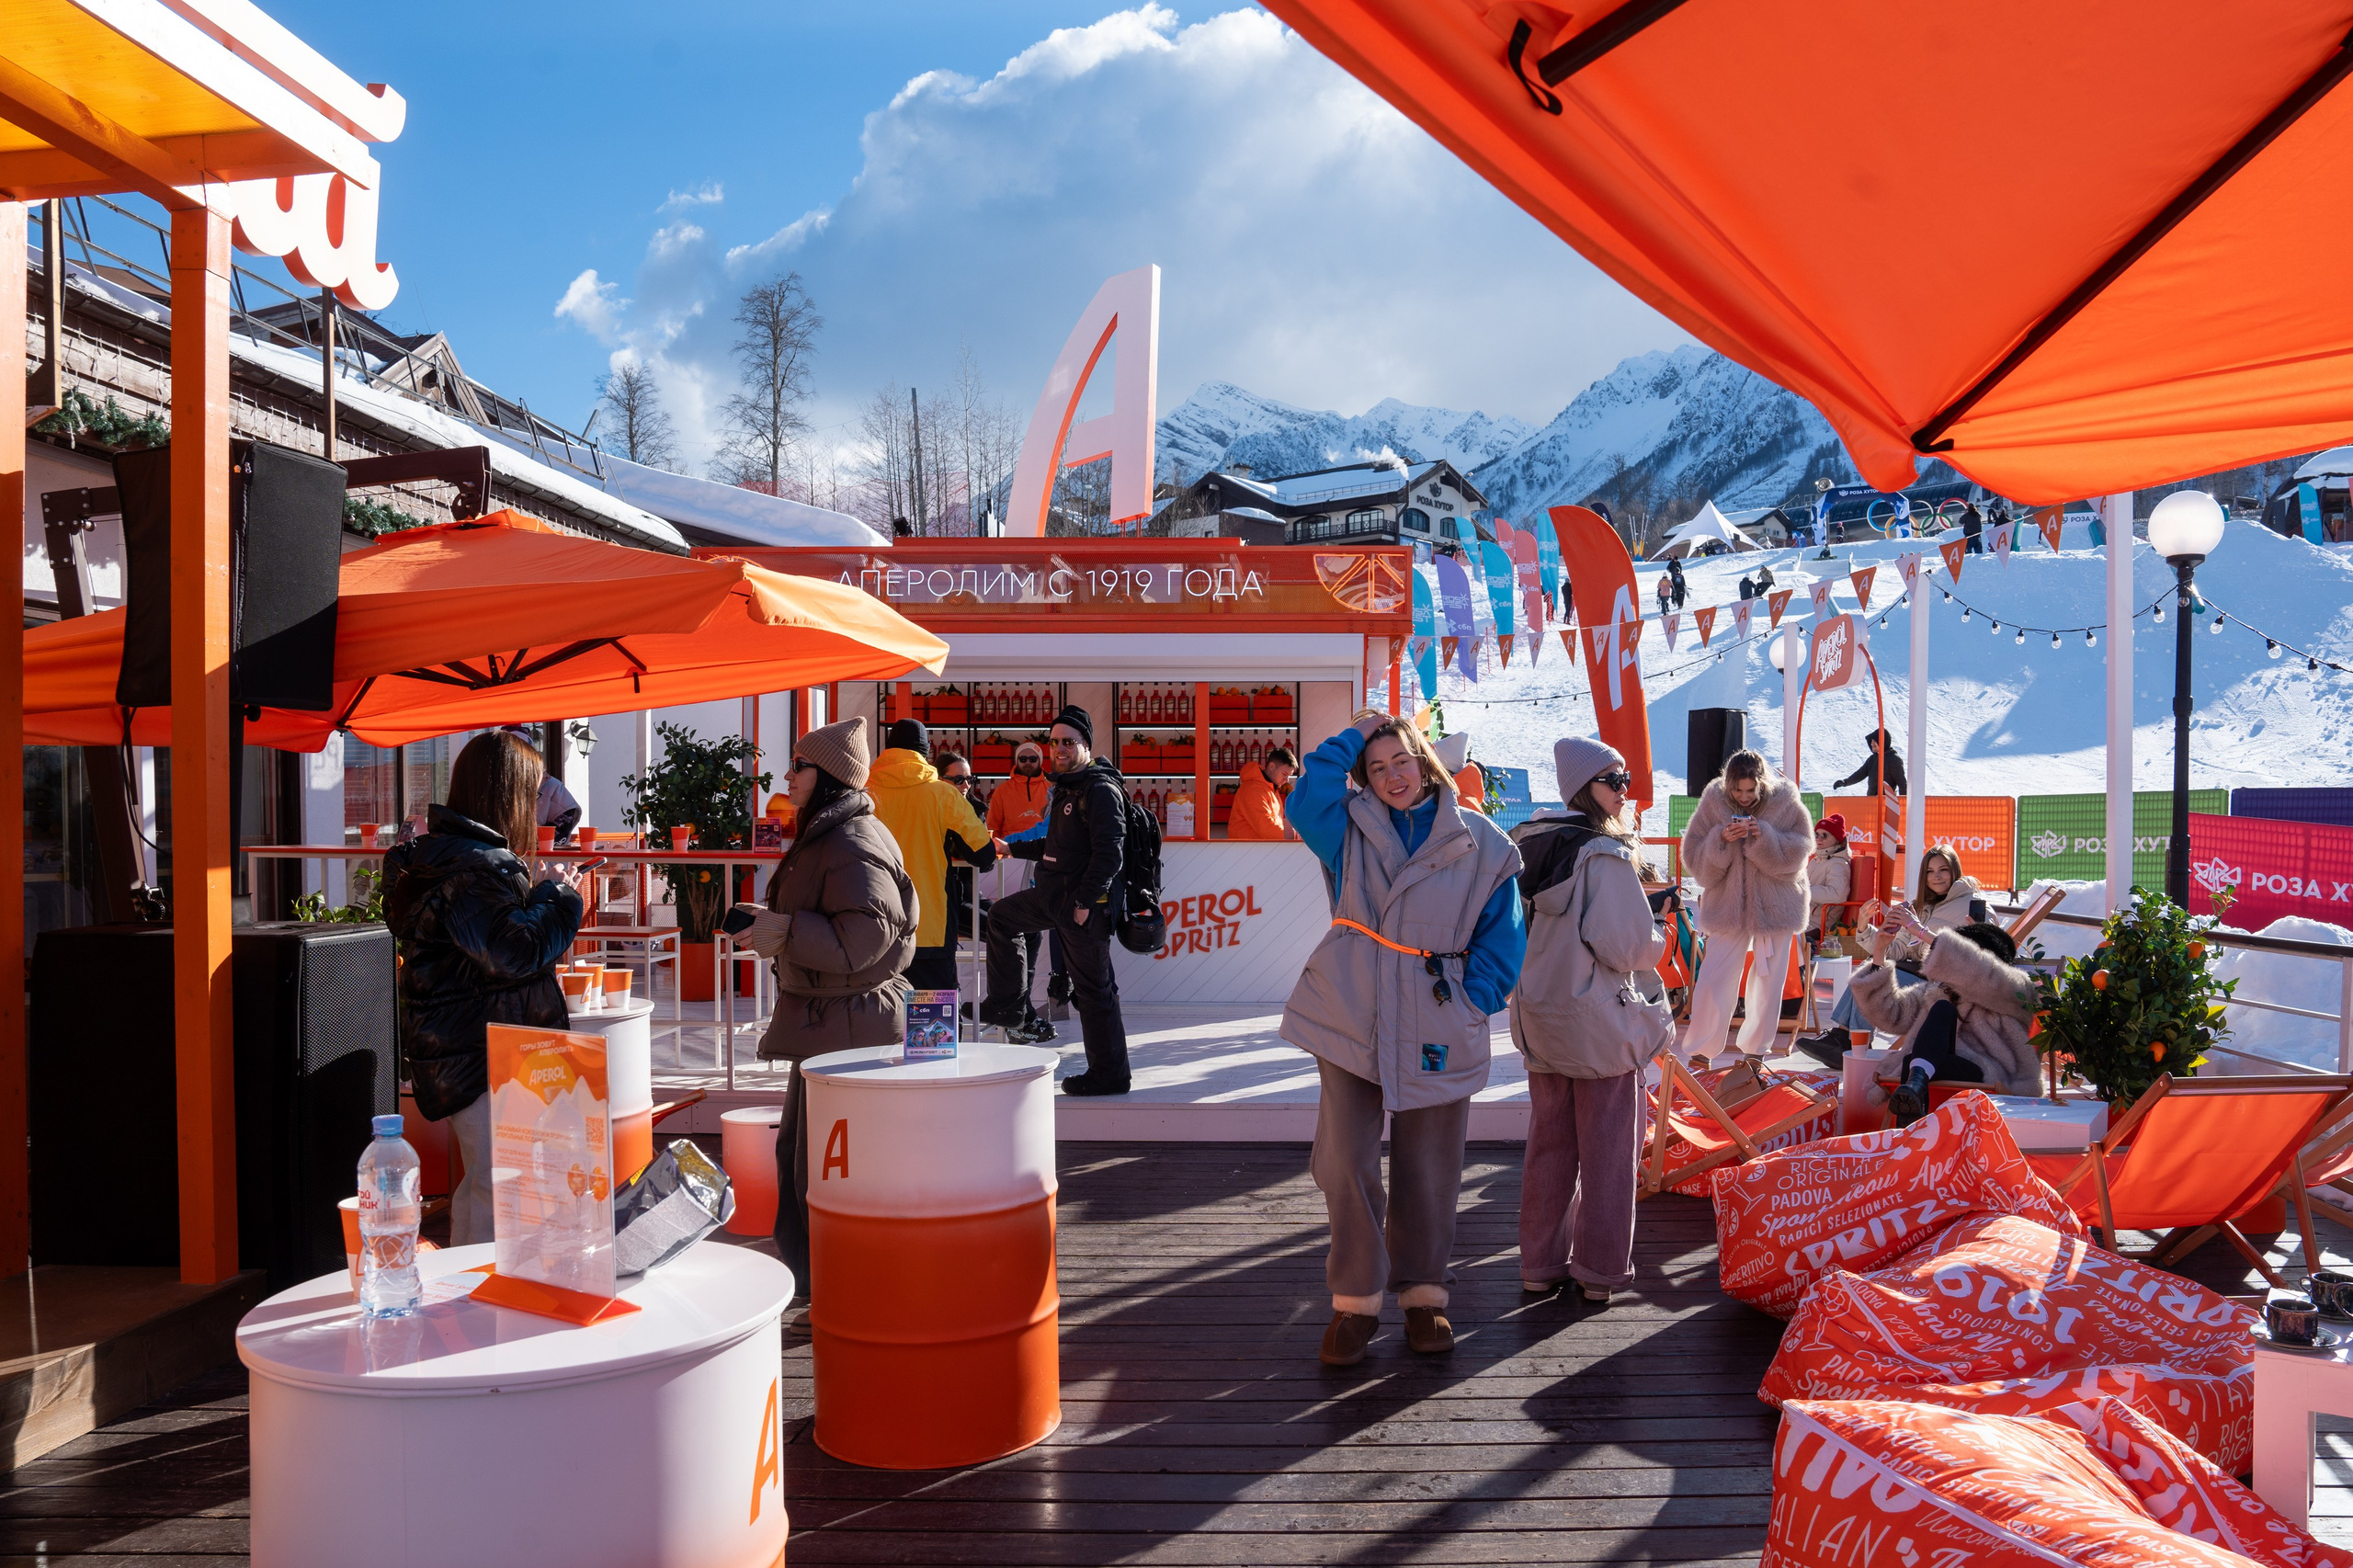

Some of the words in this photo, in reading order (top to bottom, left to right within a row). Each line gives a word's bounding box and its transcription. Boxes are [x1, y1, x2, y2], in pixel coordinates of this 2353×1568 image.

[1416, 495, 1433, 506] РОЗА
[1434, 500, 1454, 512] ХУТОР
[2046, 514, 2058, 534] A
[1996, 530, 2007, 549] A
[1949, 547, 1960, 565] A
[1906, 562, 1915, 581] A
[839, 570, 1034, 597] АПЕРОЛИМ
[1050, 570, 1073, 597] С
[1086, 570, 1153, 597] 1919
[1167, 570, 1263, 600] ГОДА
[1859, 575, 1869, 593] A
[1772, 596, 1784, 612] A
[1815, 587, 1825, 604] A
[1701, 614, 1711, 631] A
[1737, 606, 1747, 622] A
[1629, 627, 1638, 642] A
[1667, 619, 1676, 635] A
[1391, 639, 1401, 651] A
[1416, 642, 1426, 653] A
[1471, 641, 1479, 653] A
[1502, 640, 1509, 653] A
[1532, 637, 1540, 652] A
[1566, 634, 1574, 651] A
[1597, 631, 1605, 646] A
[1608, 583, 1644, 711] A
[1815, 621, 1847, 673] APEROL
[1444, 642, 1453, 655] A
[2252, 872, 2323, 899] РОЗА
[1161, 885, 1262, 932] PEROL
[519, 1043, 536, 1051] ГОРЫ
[537, 1040, 556, 1049] ЗОВУТ
[539, 1045, 574, 1057] АПЕРОЛИТЬ
[529, 1065, 566, 1085] APEROL
[822, 1118, 849, 1181] A
[1790, 1156, 1871, 1174] RICETTA
[1778, 1159, 1884, 1190] ORIGINALE
[1771, 1187, 1833, 1211] PADOVA
[1779, 1222, 1822, 1248] RADICI
[1827, 1192, 1904, 1230] SELEZIONATE
[2095, 1286, 2188, 1336] SELEZIONATE
[1949, 1308, 2053, 1353] CONTAGIOUS
[749, 1375, 779, 1527] A
[1875, 1451, 1938, 1483] RADICI
[1943, 1478, 2072, 1521] SELEZIONATE
[2129, 1534, 2179, 1558] BASE
